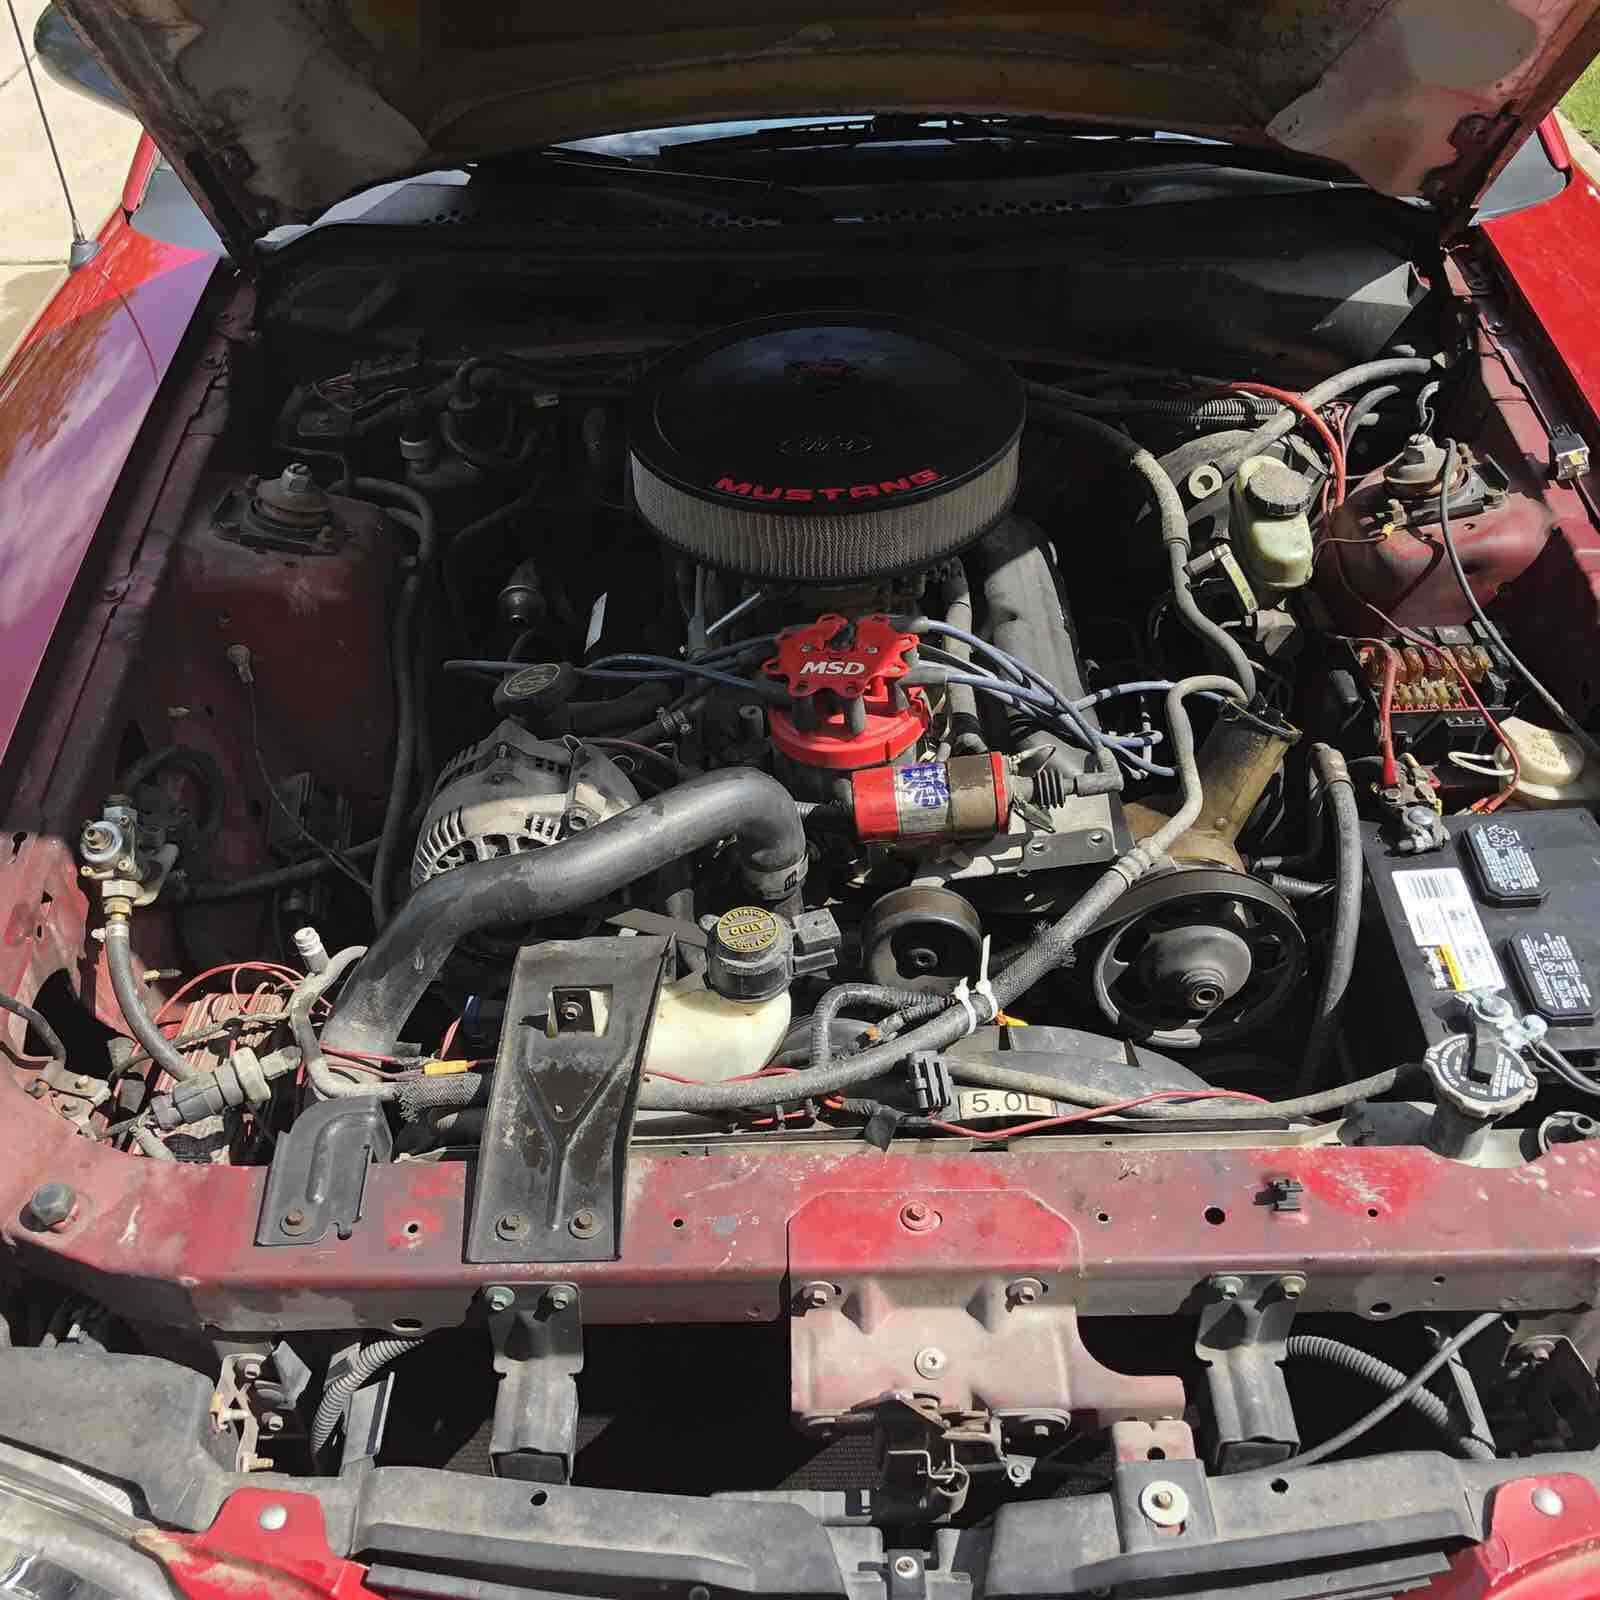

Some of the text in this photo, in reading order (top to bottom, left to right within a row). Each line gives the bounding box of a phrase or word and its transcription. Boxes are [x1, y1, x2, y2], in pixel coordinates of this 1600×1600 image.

[714, 468, 939, 501] MUSTANG
[800, 661, 865, 675] MSD
[972, 1092, 1042, 1113] 5.0L
